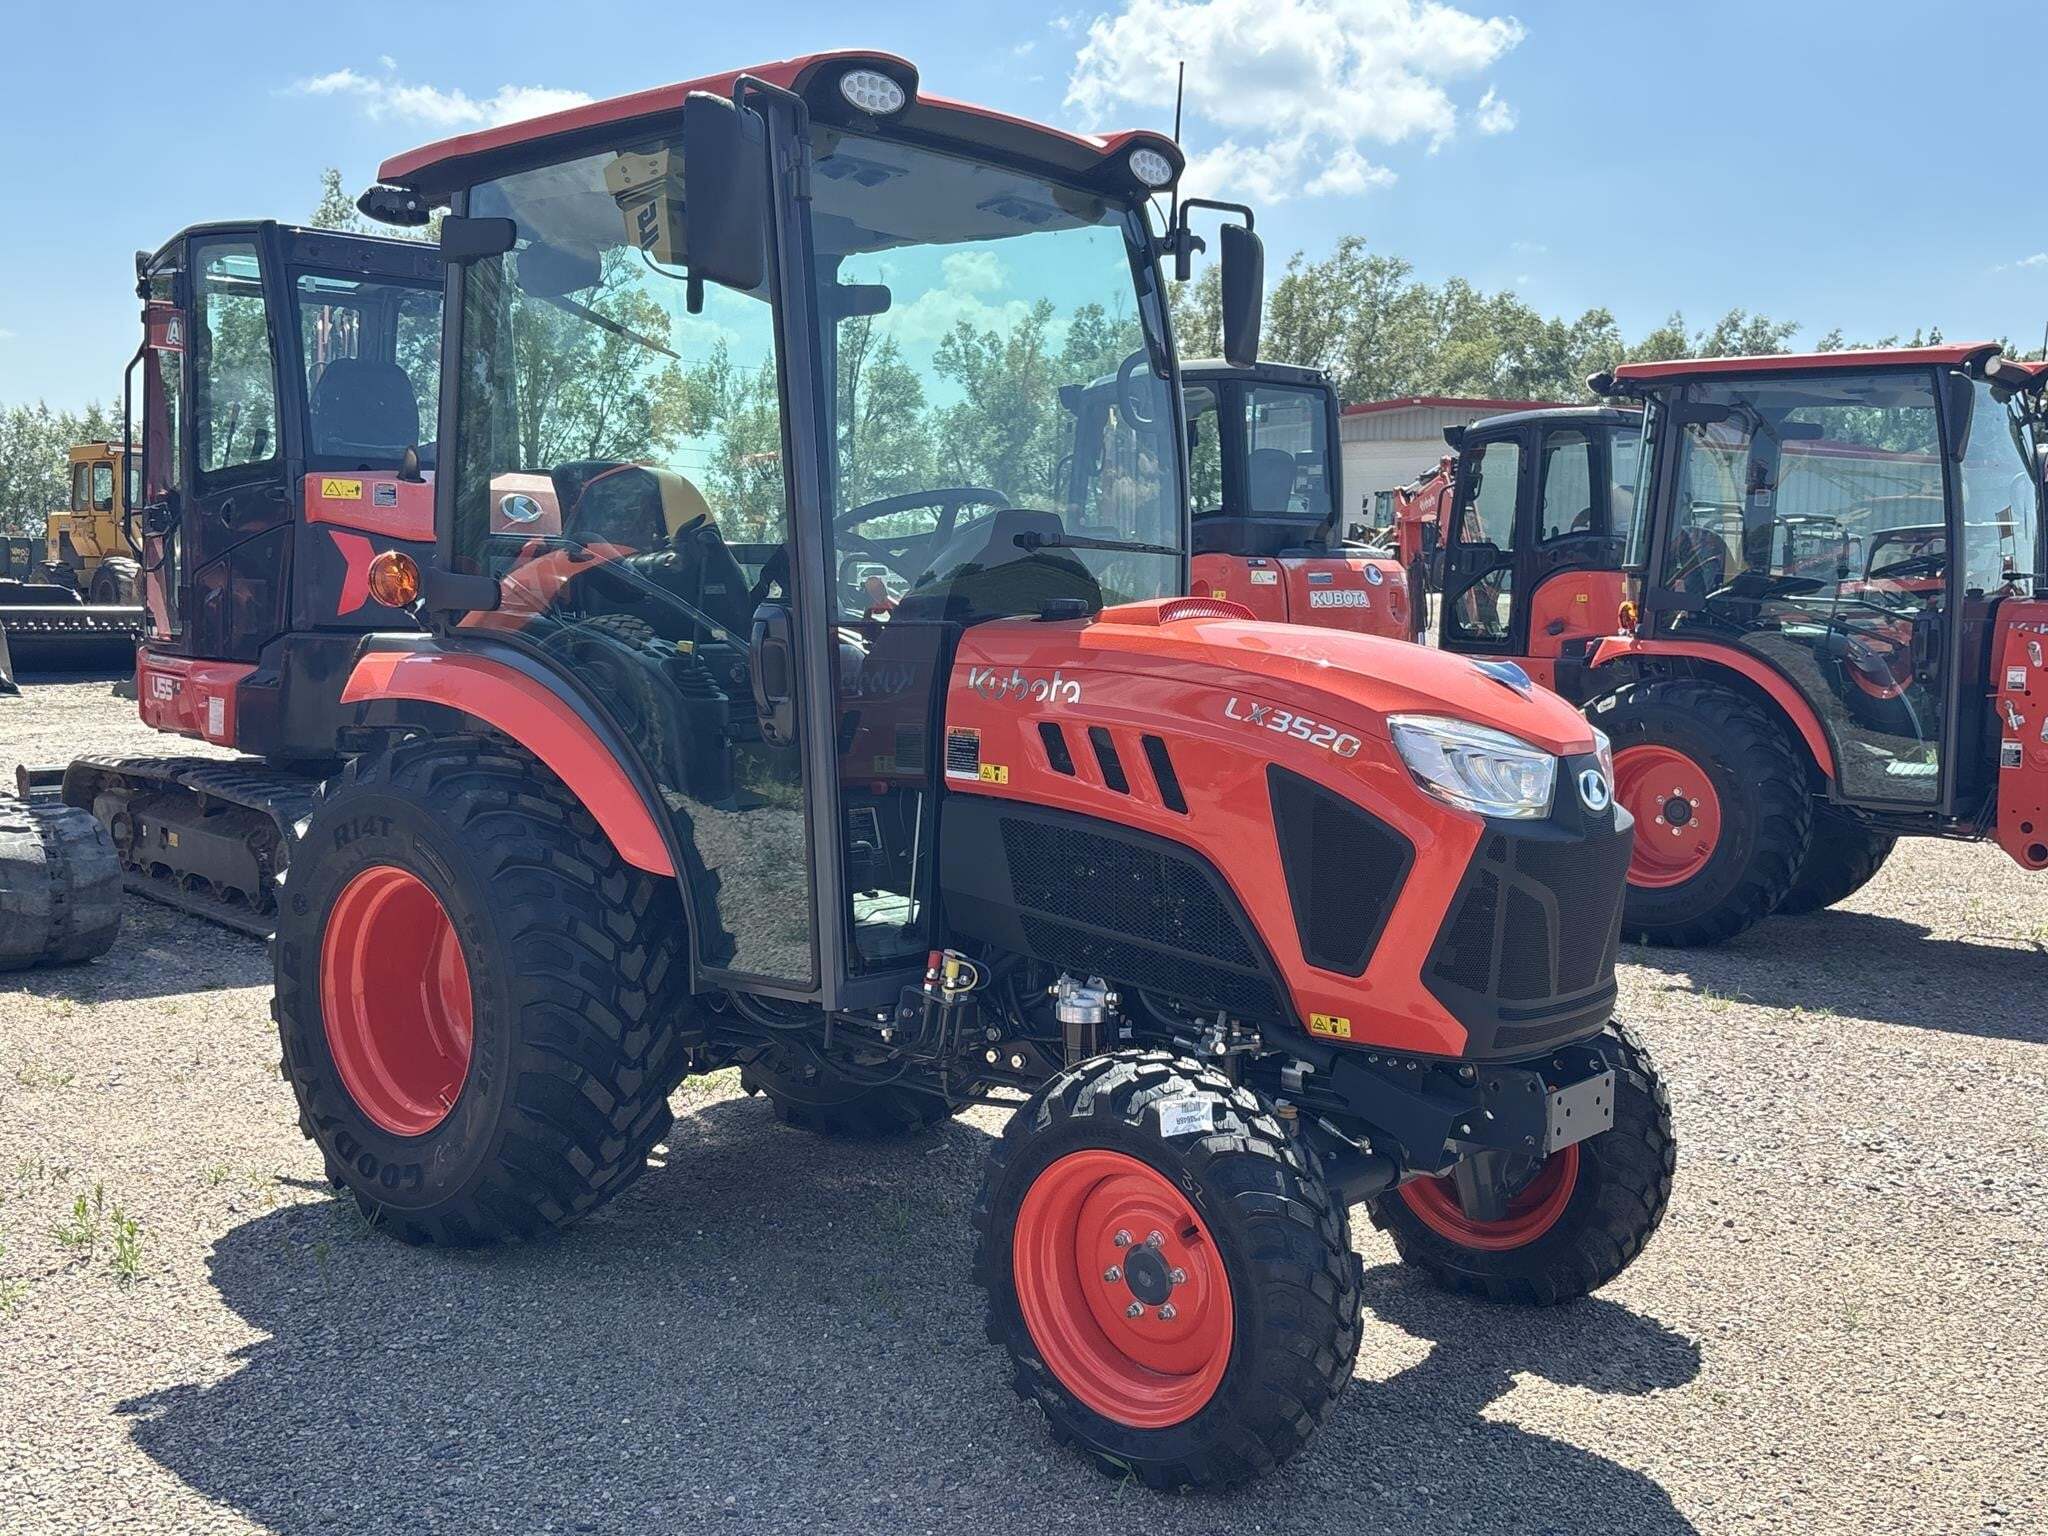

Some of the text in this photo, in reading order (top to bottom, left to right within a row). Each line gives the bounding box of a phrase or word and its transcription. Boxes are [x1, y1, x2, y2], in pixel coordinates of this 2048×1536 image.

[1310, 590, 1371, 608] KUBOTA
[967, 667, 1082, 704] Kubota
[1224, 697, 1362, 758] LX3520
[334, 815, 393, 851] R14T
